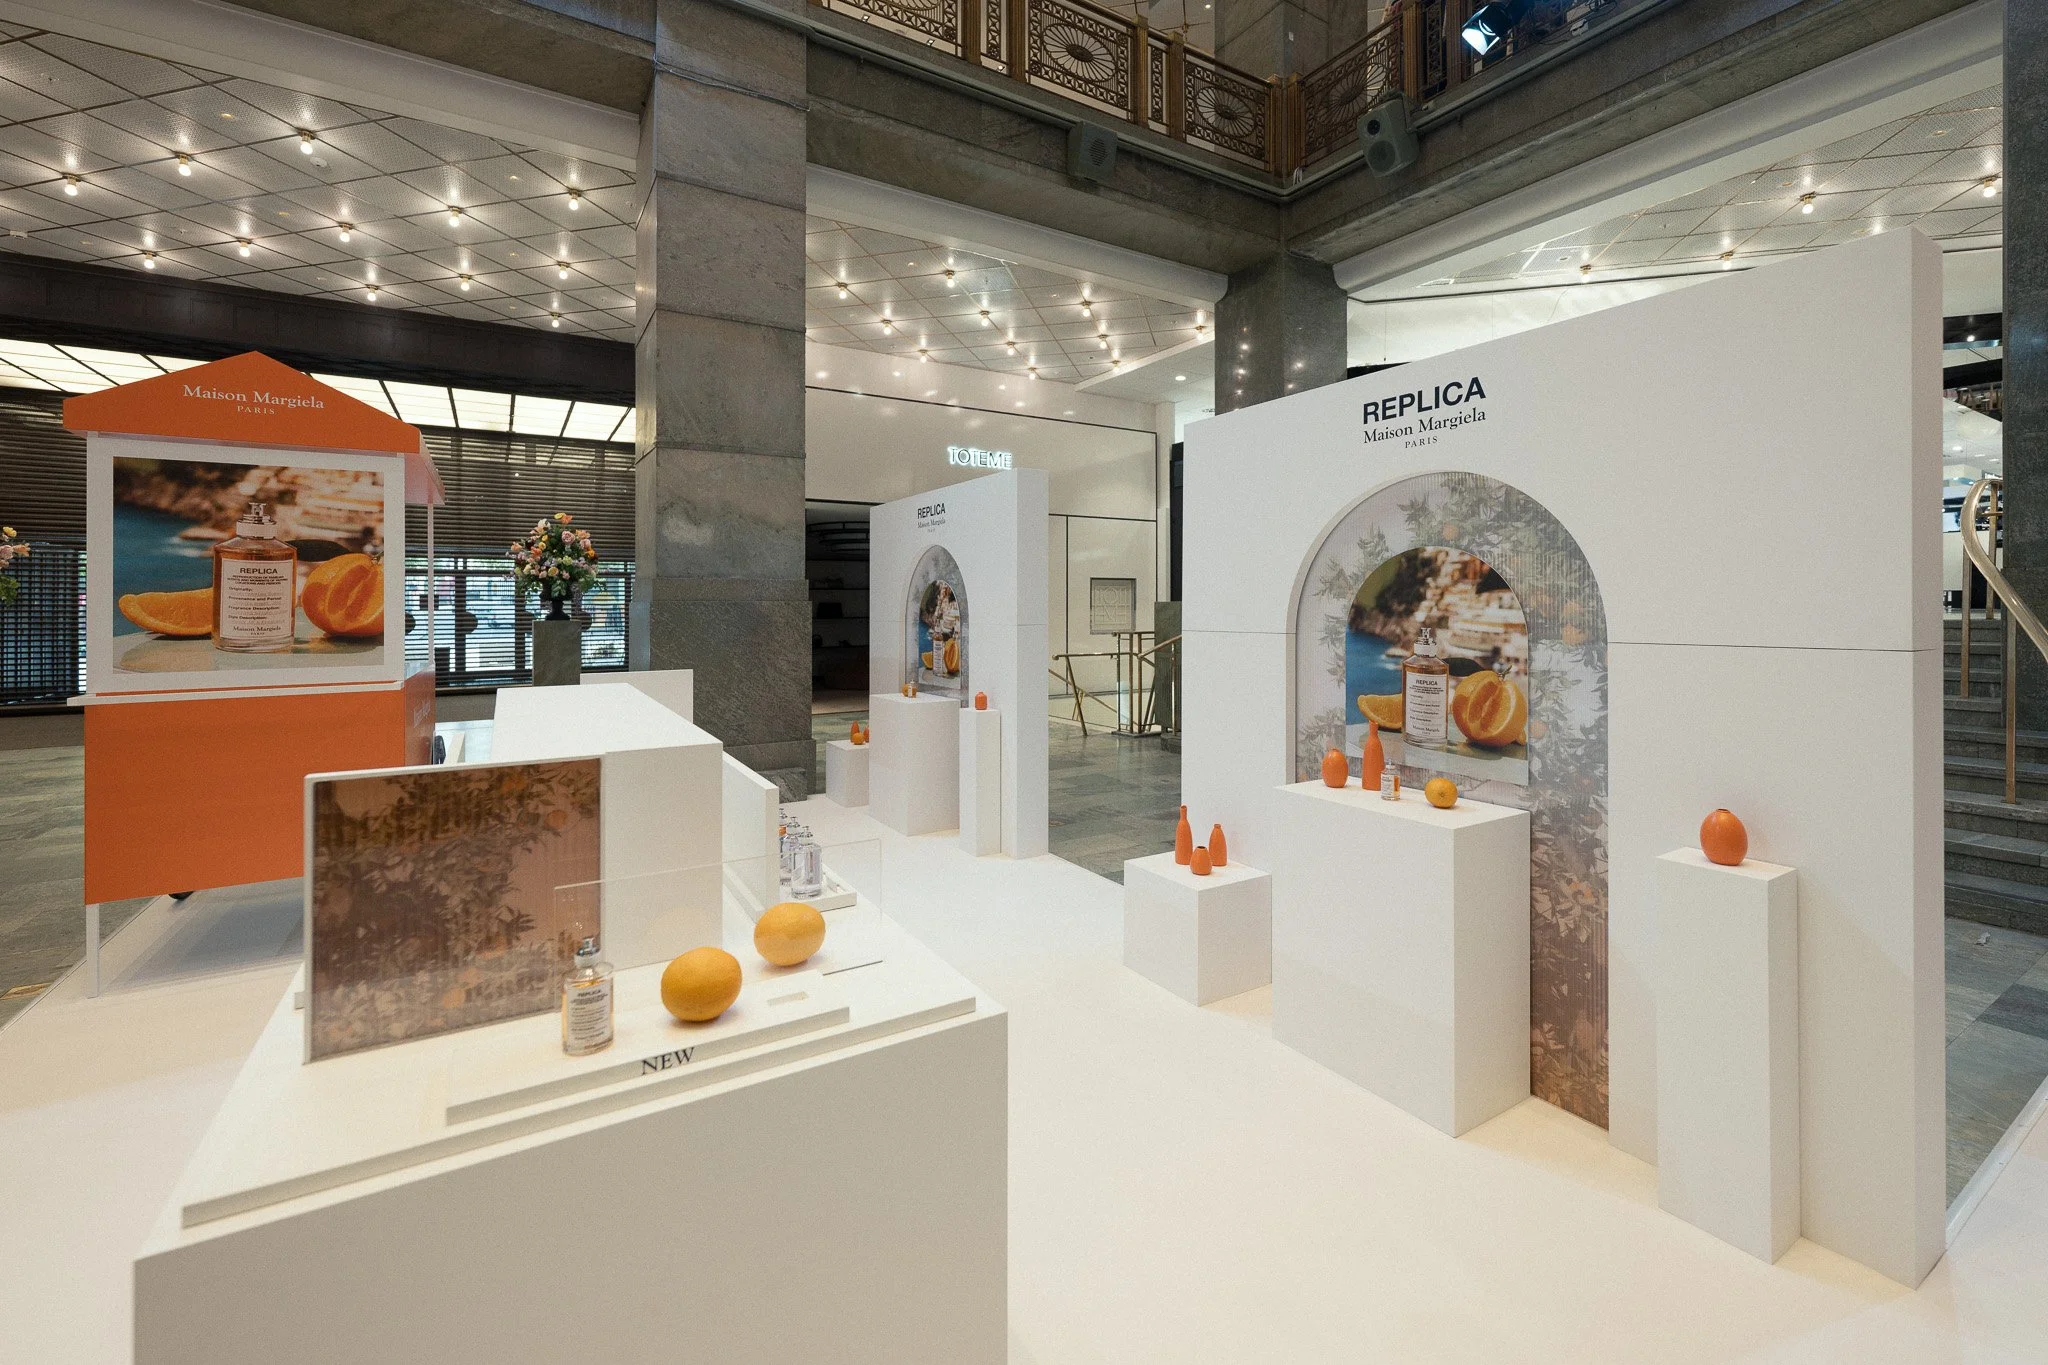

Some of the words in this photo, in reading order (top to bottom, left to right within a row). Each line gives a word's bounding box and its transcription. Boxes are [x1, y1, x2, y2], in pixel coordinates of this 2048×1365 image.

[183, 384, 248, 402] Maison
[253, 390, 325, 409] Margiela
[1363, 377, 1487, 425] REPLICA
[237, 405, 275, 415] PARIS
[1364, 426, 1414, 444] Maison
[1418, 407, 1487, 433] Margiela
[1405, 436, 1438, 449] PARIS
[948, 446, 1013, 470] TOTEME
[917, 503, 946, 519] REPLICA
[641, 1046, 695, 1076] NEW
